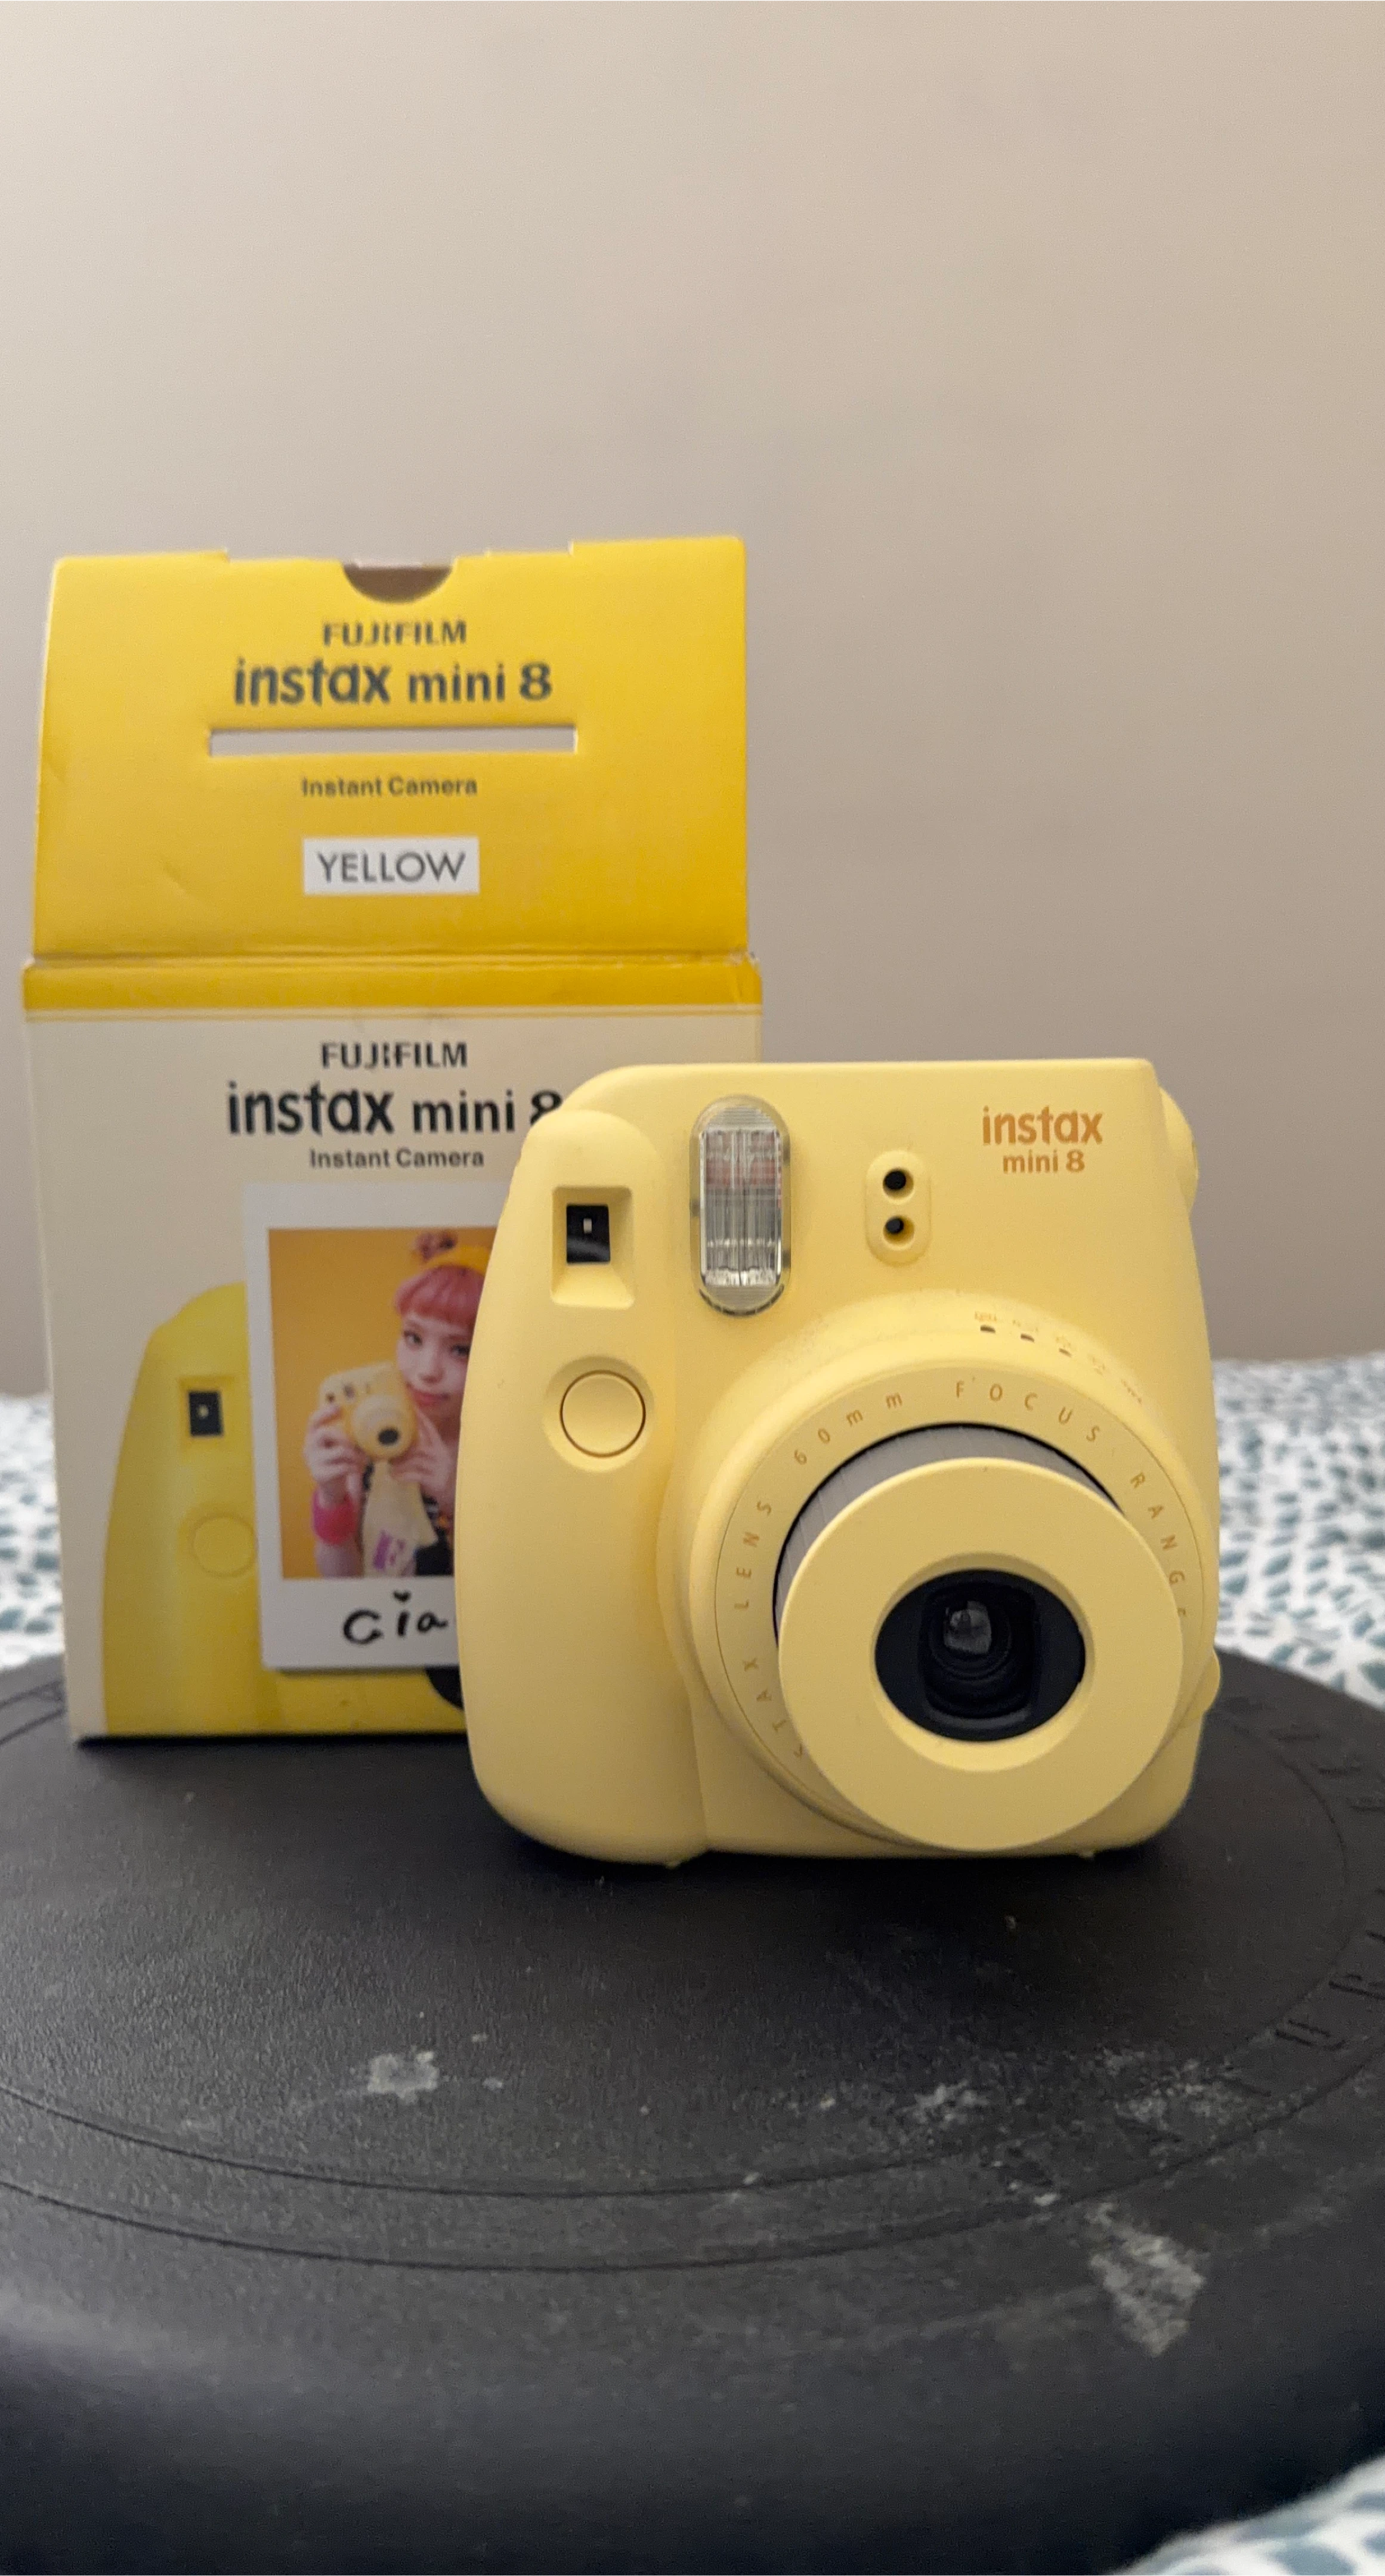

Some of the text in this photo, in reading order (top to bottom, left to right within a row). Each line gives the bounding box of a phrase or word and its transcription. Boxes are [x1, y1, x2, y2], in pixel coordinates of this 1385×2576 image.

[323, 620, 466, 646] FUJIFILM
[234, 659, 552, 705] instax mini 8
[302, 775, 478, 797] Instant Camera
[318, 852, 466, 883] YELLOW
[321, 1042, 467, 1069] FUJIFILM
[228, 1081, 394, 1135] instax
[413, 1090, 515, 1132] mini
[982, 1106, 1103, 1145] instax
[310, 1147, 484, 1169] Instant Camera
[1003, 1149, 1085, 1174] mini 8
[734, 1500, 772, 1609] LENS
[793, 1392, 903, 1466] 60mm
[956, 1380, 1100, 1442] FOCUS
